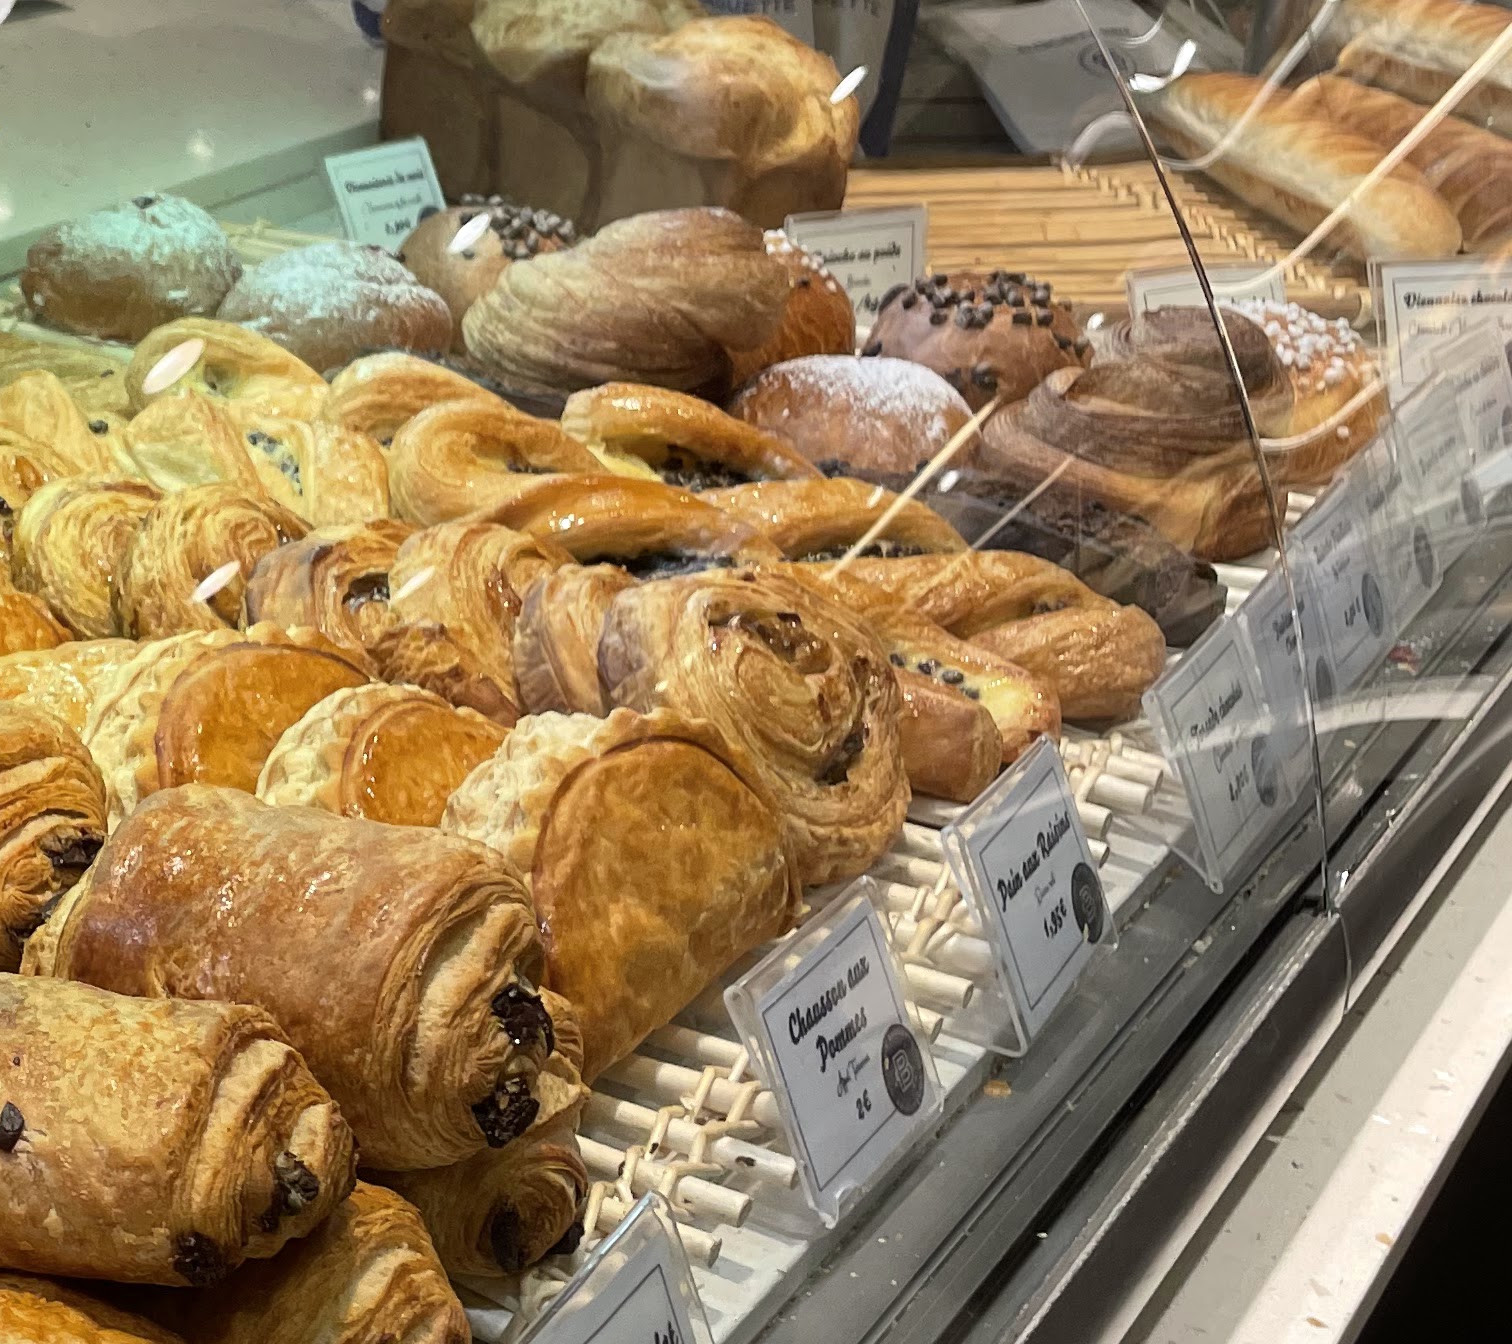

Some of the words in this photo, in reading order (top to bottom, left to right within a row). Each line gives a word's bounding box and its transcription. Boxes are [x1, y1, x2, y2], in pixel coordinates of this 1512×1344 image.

[997, 867, 1023, 913] Pain
[1022, 849, 1040, 882] aux
[1037, 810, 1071, 860] Raisins
[788, 979, 848, 1046] Chausson
[847, 955, 870, 991] aux
[815, 1006, 869, 1074] Pommes
[855, 1087, 873, 1120] 2€
